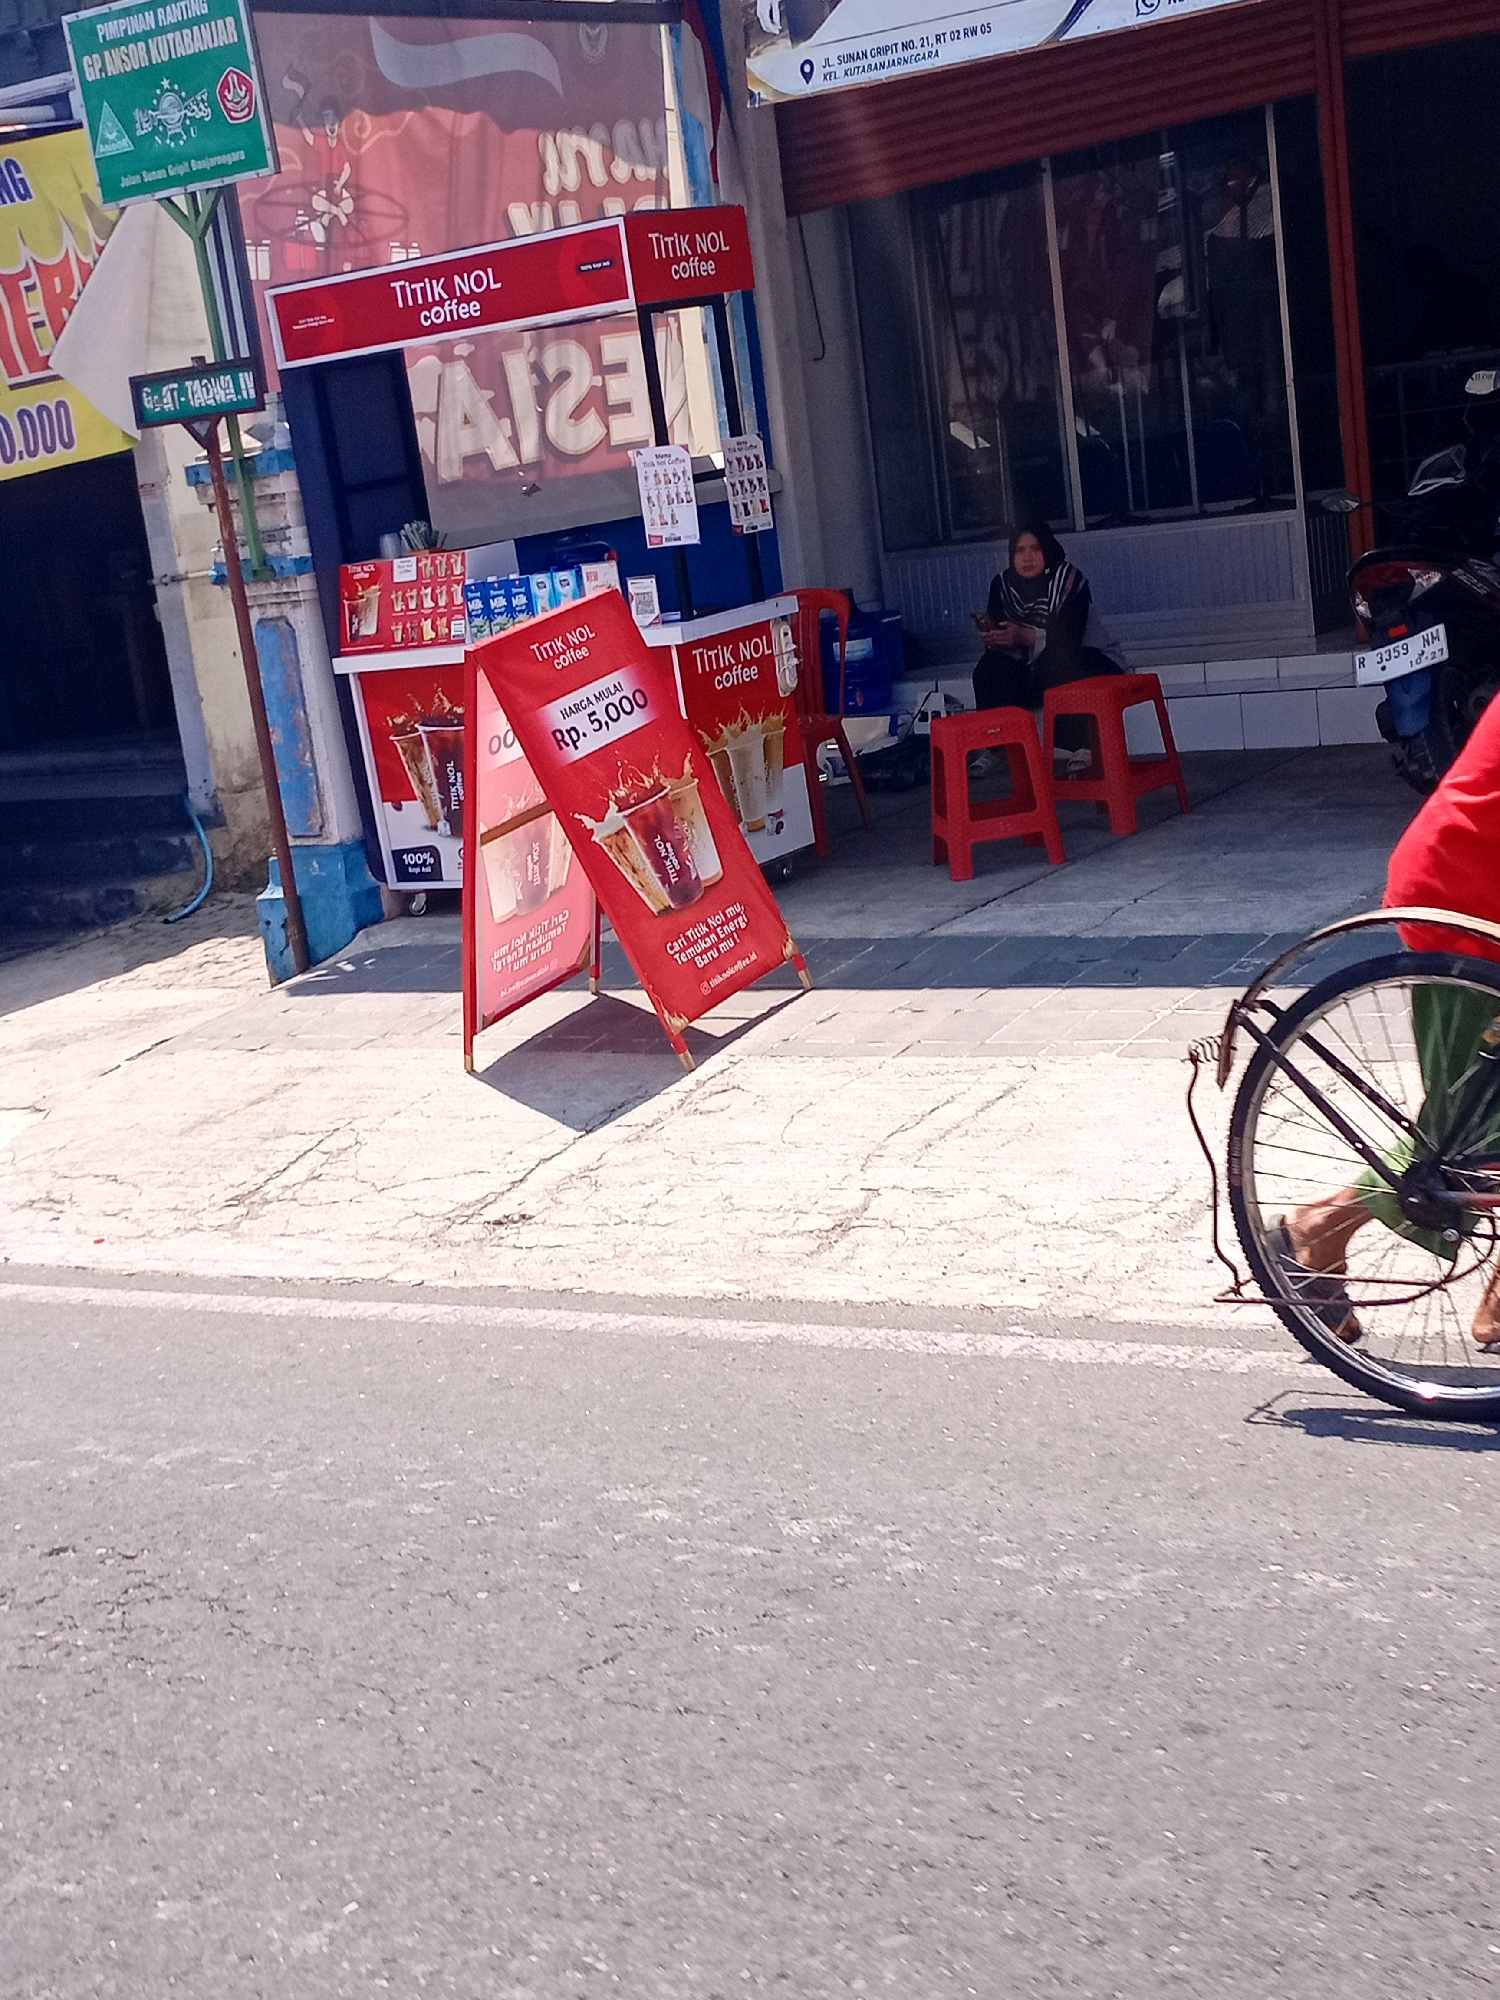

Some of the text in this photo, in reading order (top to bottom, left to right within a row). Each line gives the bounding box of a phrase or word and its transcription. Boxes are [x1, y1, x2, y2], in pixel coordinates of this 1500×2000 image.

[96, 0, 208, 43] PIMPINAN RANTING
[83, 16, 238, 82] GP. ANSOR KUTABANJAR
[837, 49, 868, 66] SUNAN
[869, 42, 899, 59] GRIPIT
[900, 39, 918, 51] NO.
[919, 36, 934, 49] 21,
[935, 32, 947, 46] RT
[949, 29, 961, 42] 02
[962, 26, 979, 39] RW
[980, 22, 992, 35] 05
[843, 48, 940, 78] KUTABANJARNEGARA
[142, 168, 167, 182] Sunan
[695, 230, 730, 254] NOL
[453, 266, 502, 296] NOL
[671, 256, 716, 280] coffee
[420, 298, 481, 327] coffee
[566, 624, 597, 646] NOL
[738, 635, 773, 663] NOL
[1358, 628, 1441, 670] R 3359 NM
[553, 646, 590, 670] coffee
[714, 664, 759, 691] coffee
[559, 681, 625, 721] HARGA MULAI
[550, 687, 649, 751] Rp. 5,000
[446, 760, 456, 783] NOL
[402, 852, 434, 866] 100%
[654, 834, 668, 858] NOL
[666, 933, 688, 955] Cari
[685, 922, 709, 942] Titik
[707, 909, 726, 929] Nol
[673, 911, 748, 966] Temukan Energi
[694, 947, 719, 969] Baru
[718, 937, 735, 954] mu
